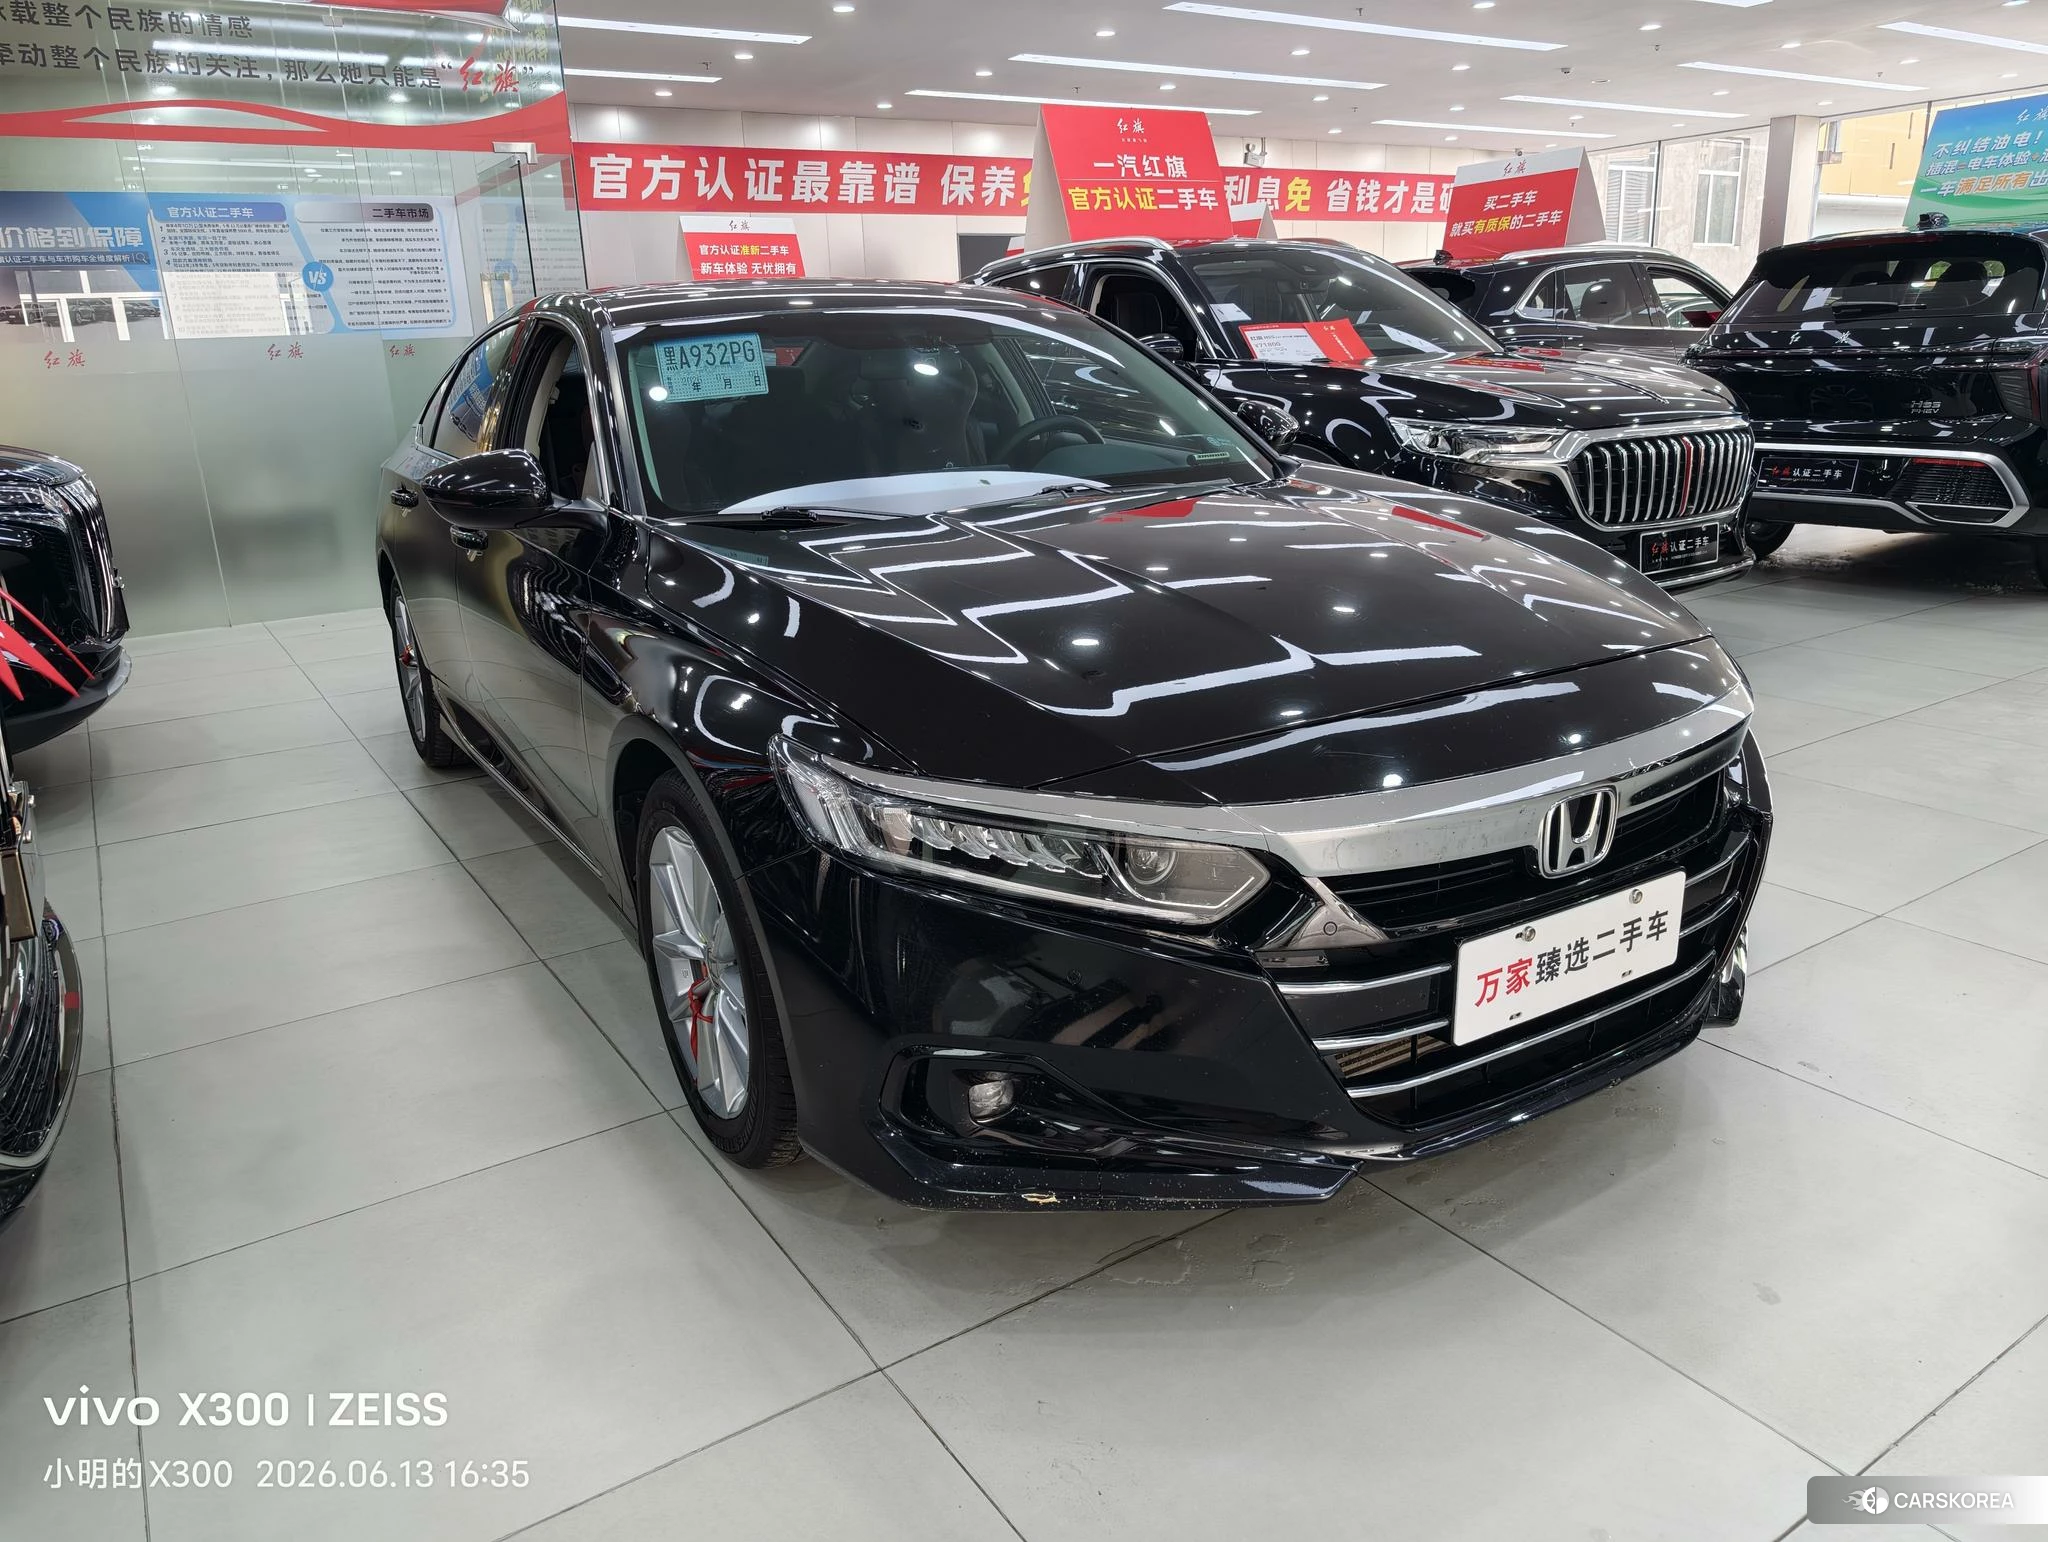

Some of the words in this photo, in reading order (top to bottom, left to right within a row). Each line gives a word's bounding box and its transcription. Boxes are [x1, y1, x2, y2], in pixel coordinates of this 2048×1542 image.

[1094, 154, 1188, 179] 一汽红旗
[589, 153, 920, 205] 官方认证最靠谱
[1224, 175, 1312, 213] 利息免
[1068, 187, 1219, 211] 官方认证二手车
[1483, 189, 1538, 211] 买二手车
[167, 206, 254, 219] 官方认证二手车
[372, 208, 429, 219] 二手车市场
[1449, 209, 1564, 237] 就买有质保的二手车
[0, 227, 144, 248] 价格到保障
[699, 245, 789, 256] 官方认证准新二手车
[308, 271, 327, 285] VS
[701, 262, 748, 275] 新车体验
[751, 263, 796, 275] 无忧拥有
[664, 340, 756, 371] 黑A932PG
[1474, 910, 1669, 1008] 万家臻选二手车
